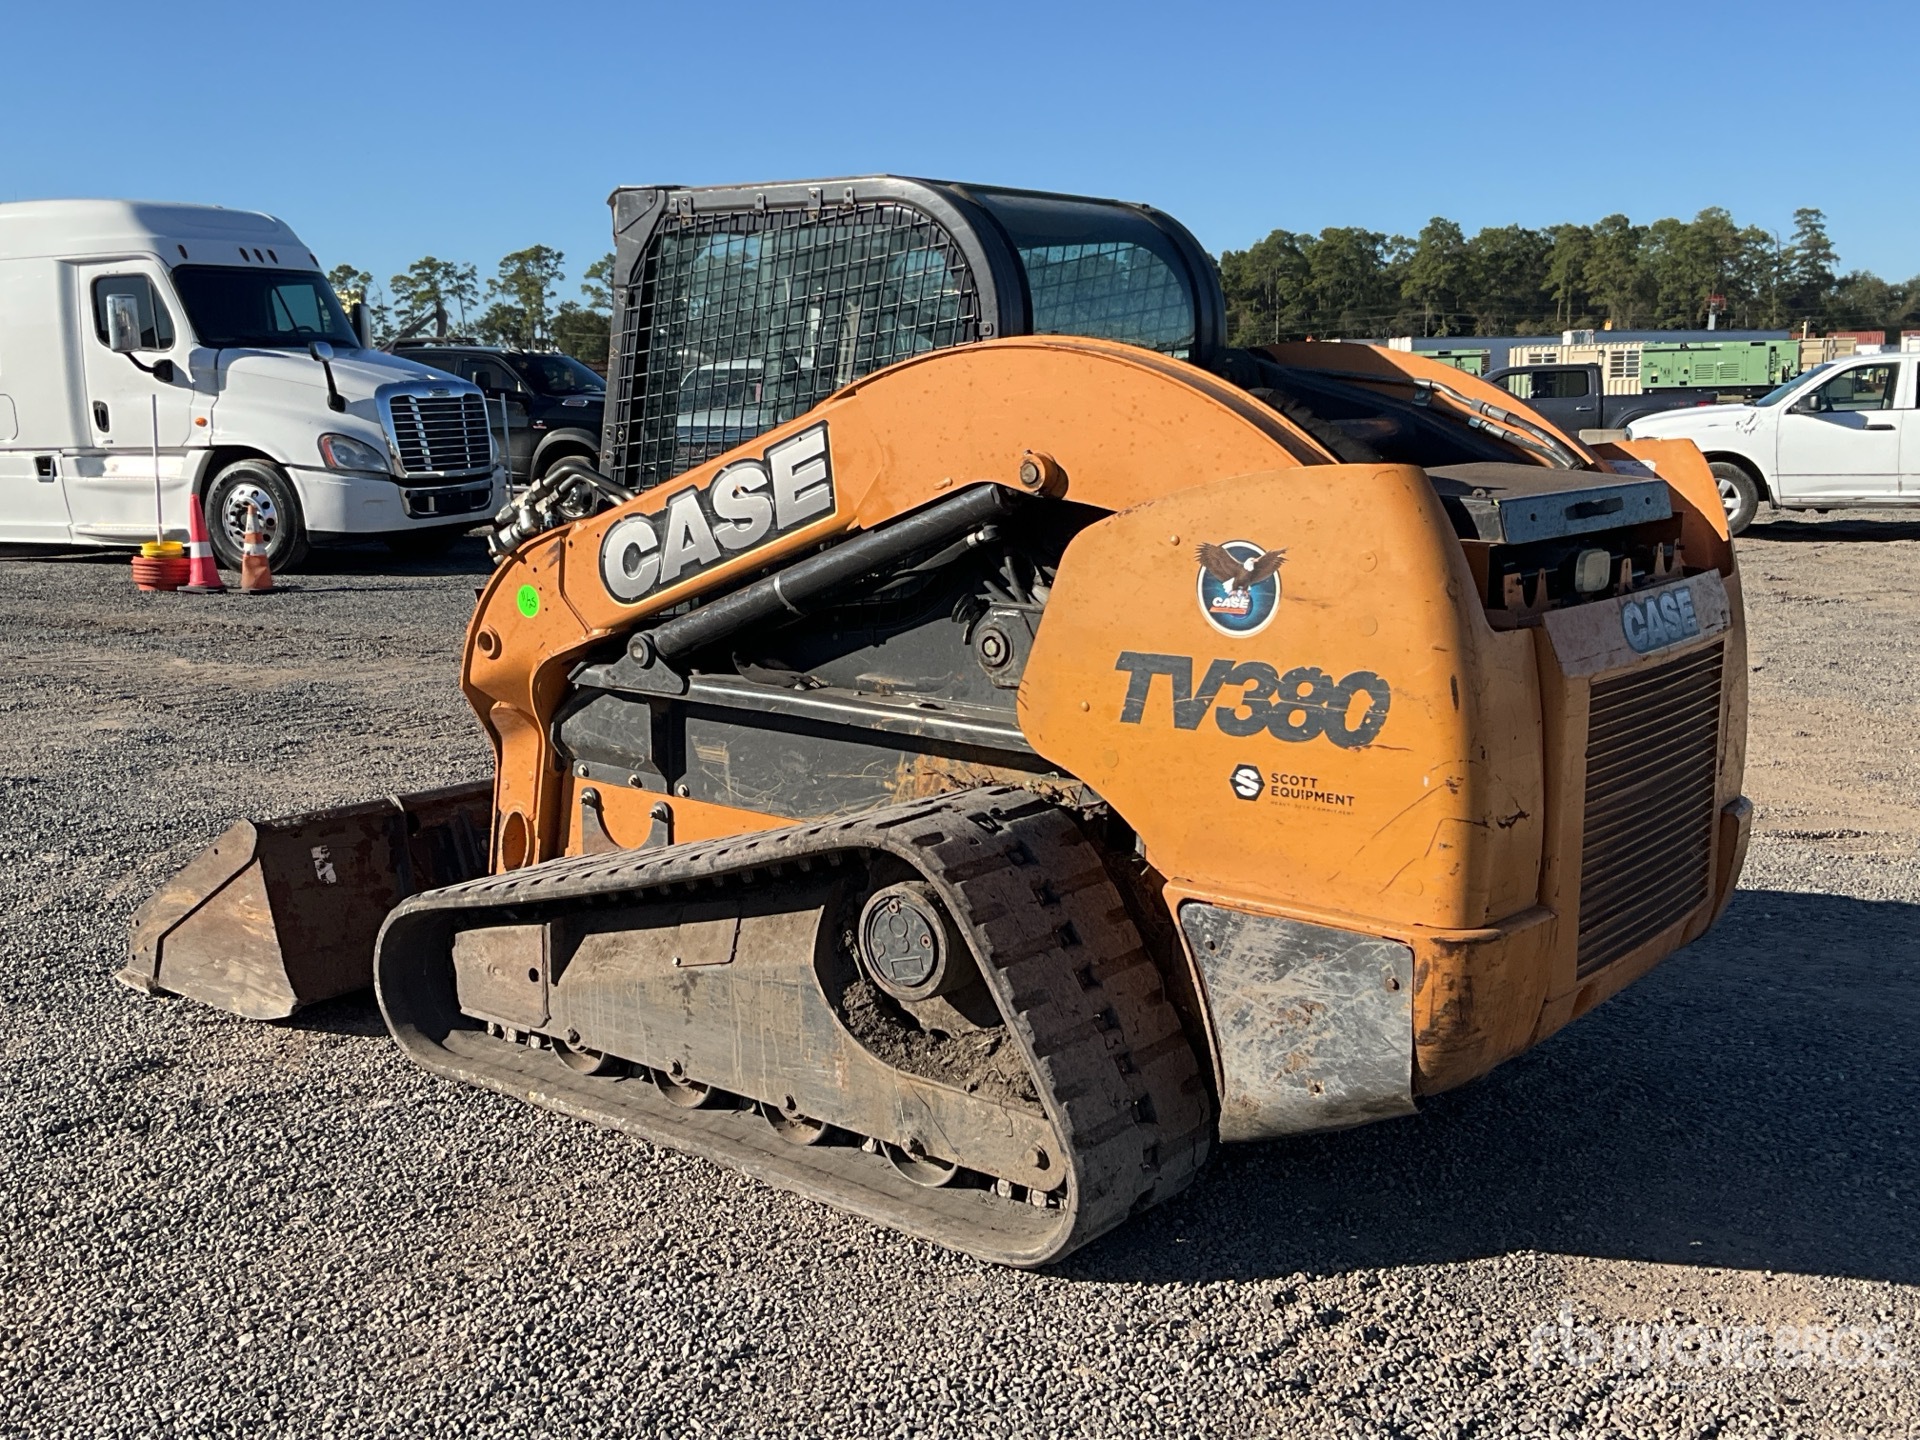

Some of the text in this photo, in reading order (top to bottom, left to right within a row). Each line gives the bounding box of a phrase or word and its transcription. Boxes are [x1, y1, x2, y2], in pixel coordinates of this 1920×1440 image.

[600, 424, 835, 603] CASE
[1212, 597, 1250, 609] CASE
[1622, 586, 1699, 653] CASE
[1115, 651, 1391, 750] TV380
[1271, 772, 1318, 789] SCOTT
[1271, 786, 1355, 806] EQUIPMENT
